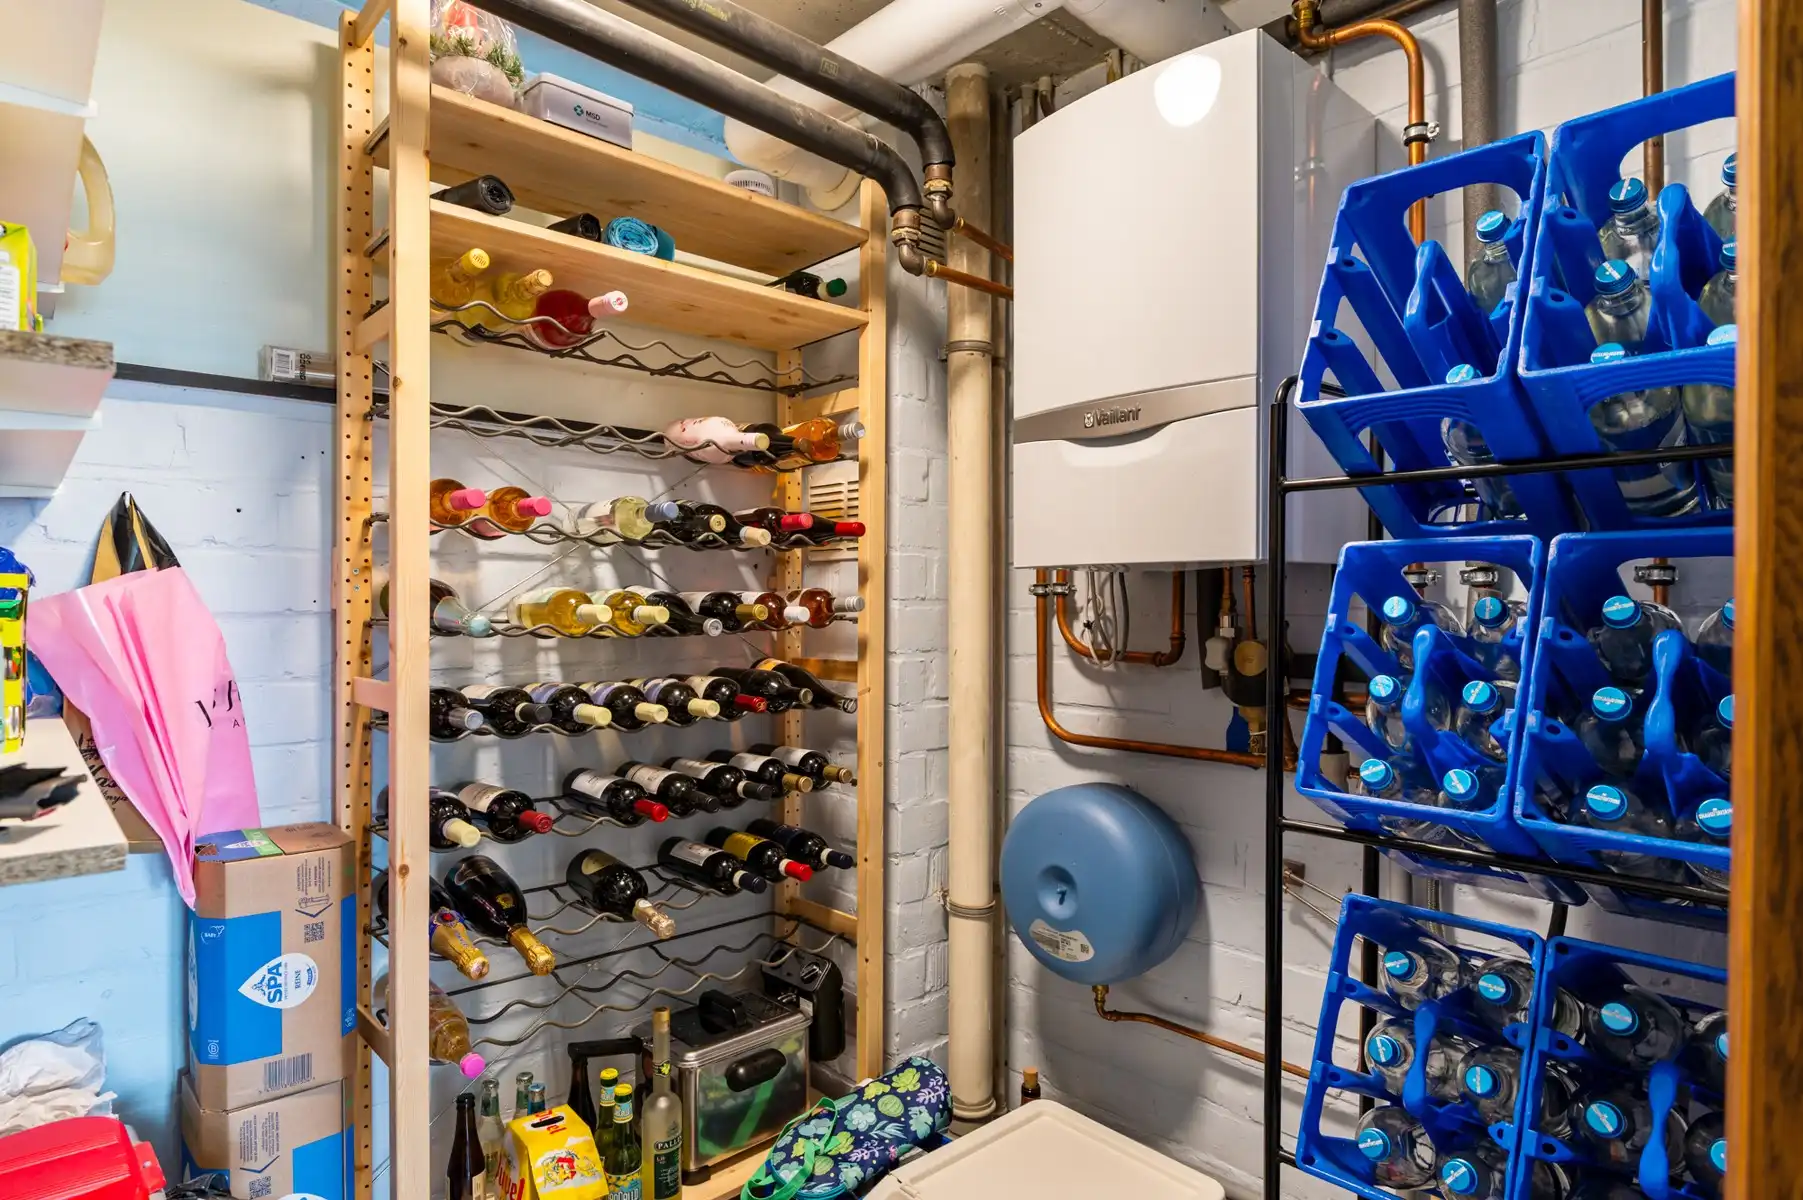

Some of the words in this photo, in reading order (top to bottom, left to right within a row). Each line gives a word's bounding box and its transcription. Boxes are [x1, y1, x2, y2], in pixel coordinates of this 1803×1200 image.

[585, 110, 601, 120] MSD
[1095, 404, 1141, 426] Vaillant
[267, 961, 283, 1003] SPA
